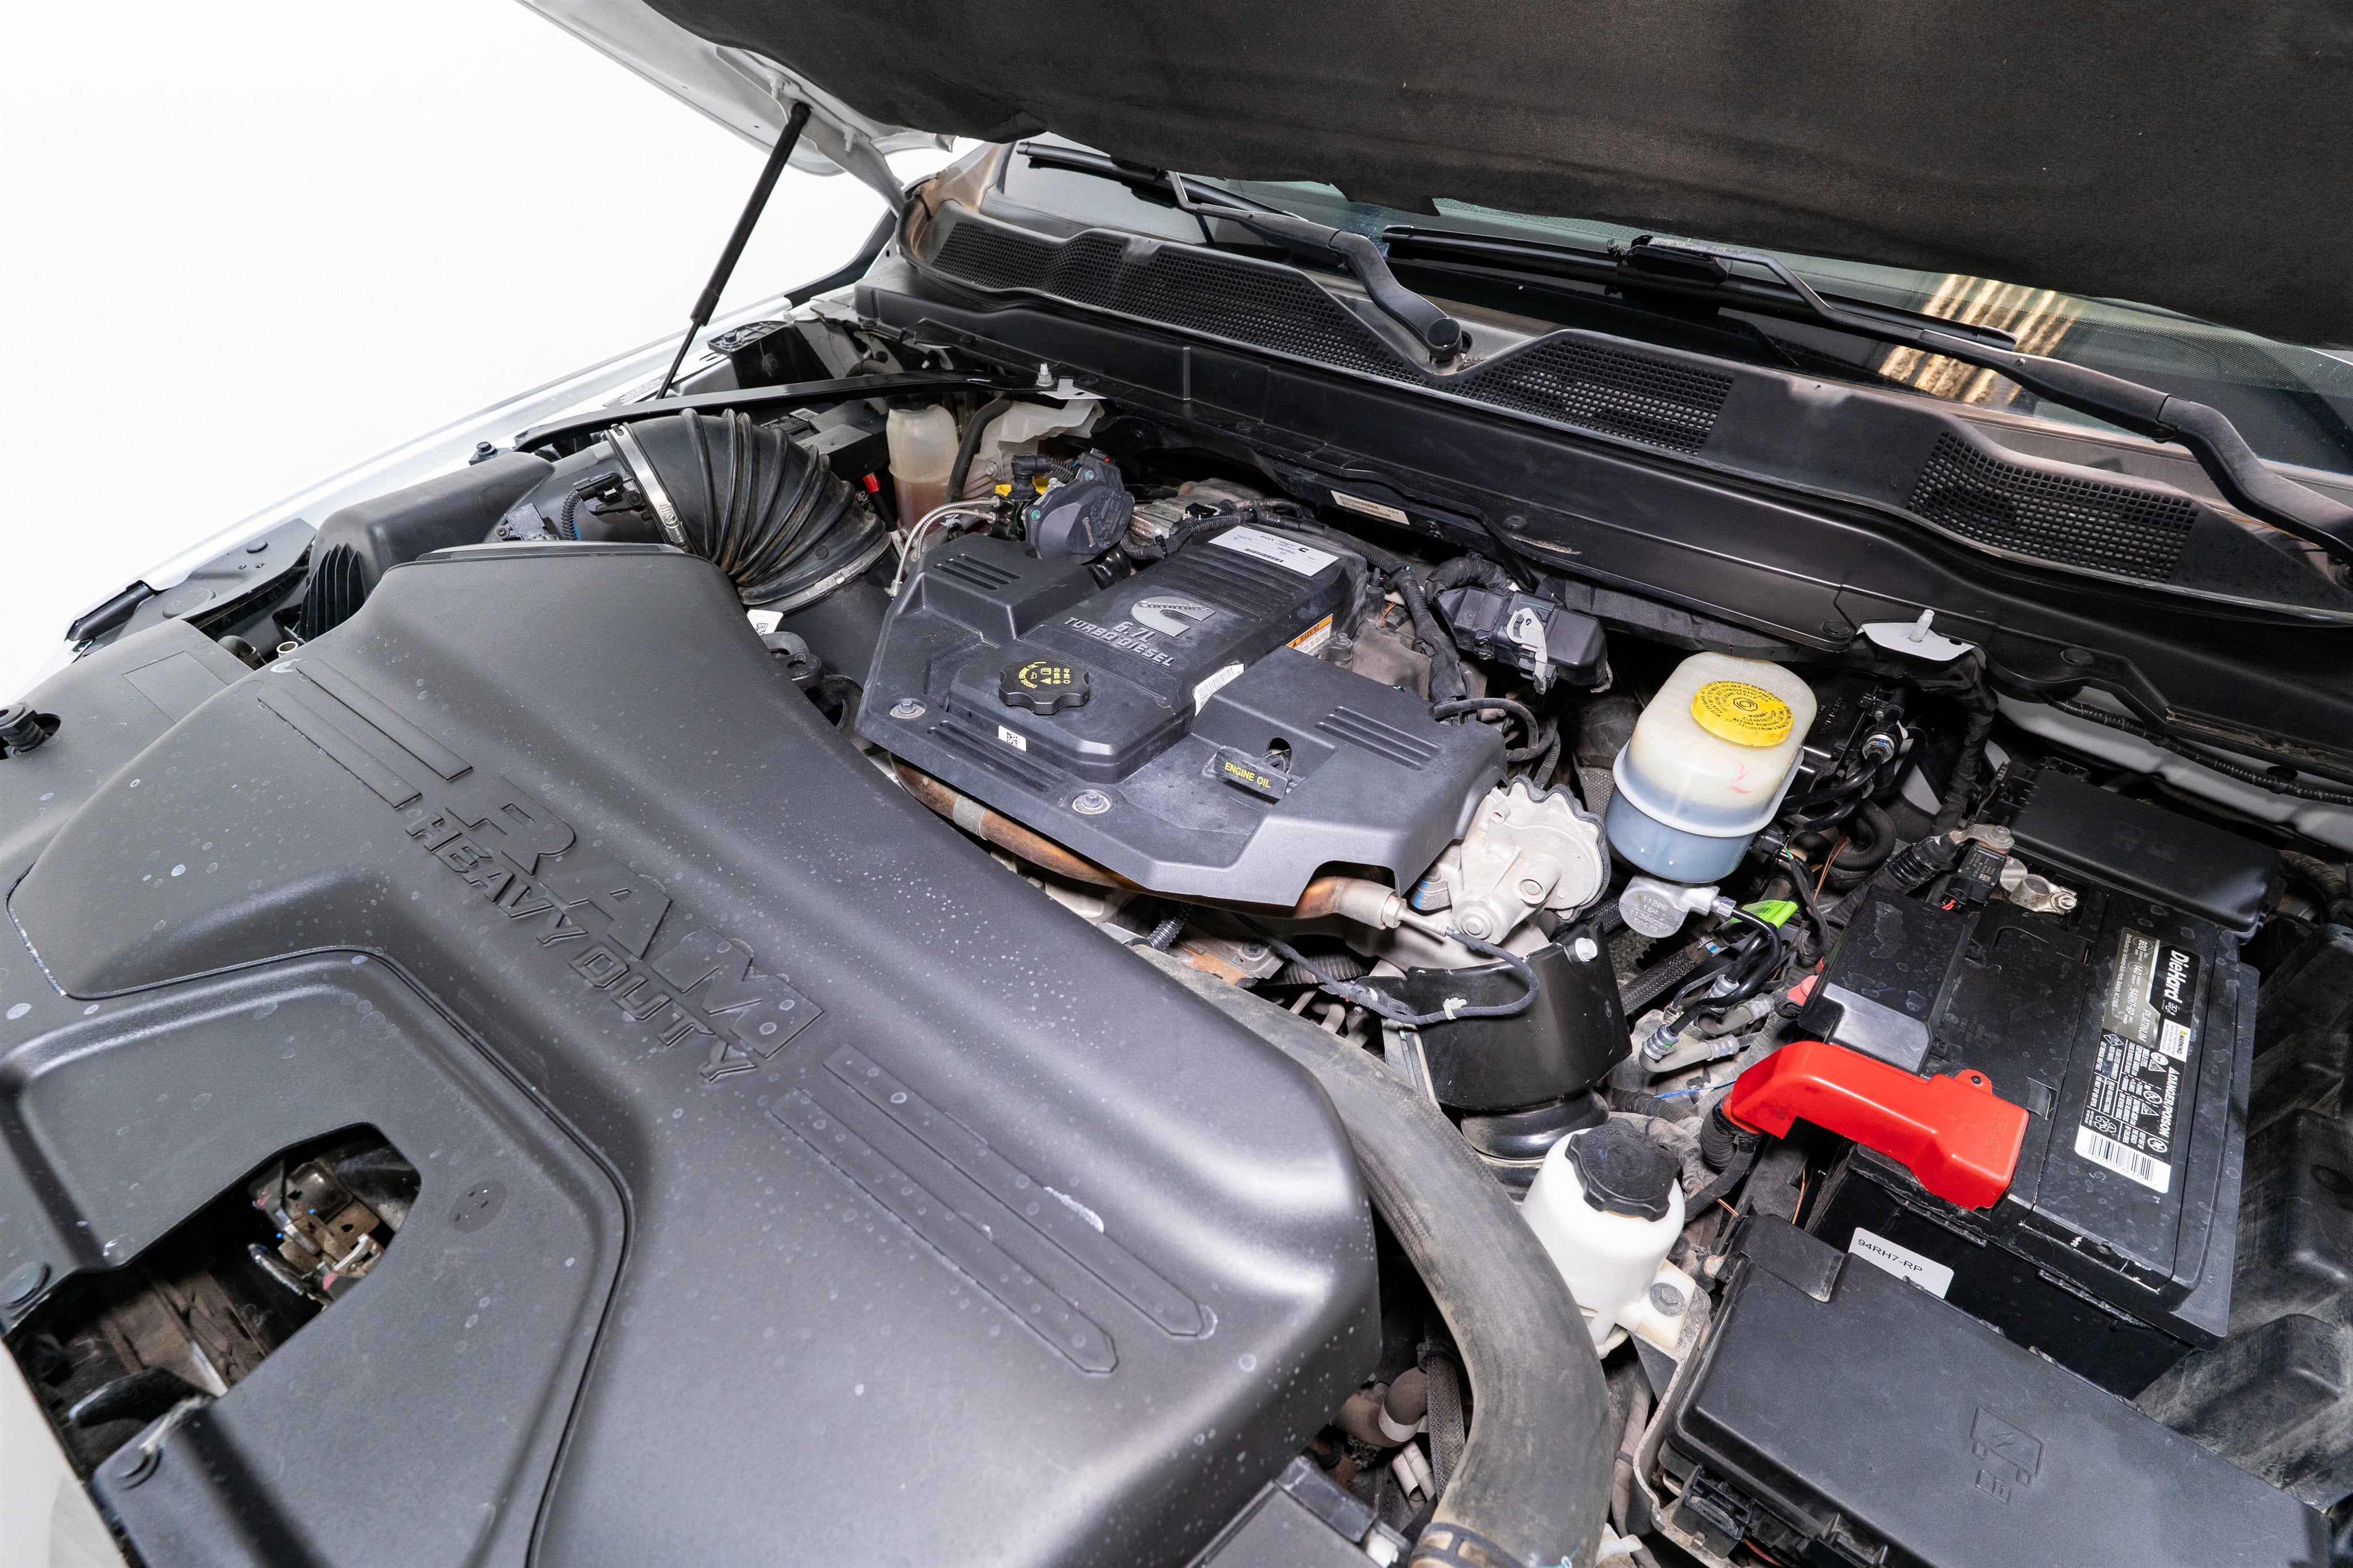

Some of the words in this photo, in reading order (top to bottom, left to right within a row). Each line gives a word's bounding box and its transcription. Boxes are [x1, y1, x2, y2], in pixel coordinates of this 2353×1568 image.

[1082, 517, 1096, 548] Continental
[1137, 601, 1211, 612] Cummins
[1113, 621, 1156, 644] 6.7L
[1300, 624, 1320, 642] WARNING
[1064, 617, 1120, 642] TURBO
[1116, 636, 1175, 668] DIESEL
[1732, 717, 1754, 725] BEFORE
[1224, 762, 1255, 782] ENGINE
[1256, 776, 1271, 789] OIL
[446, 775, 824, 1059] RAM
[1644, 905, 1658, 915] 164
[1633, 917, 1659, 933] 50673
[404, 813, 588, 947] HEAVY
[569, 944, 758, 1083] DUTY
[2123, 933, 2132, 949] Distributed
[2137, 939, 2148, 952] 800
[2120, 952, 2128, 966] Advance
[2132, 964, 2143, 976] 140
[2163, 949, 2190, 1005] DieHard
[2124, 986, 2139, 1016] 94RH7-RP
[2136, 1007, 2151, 1042] PLATINUM
[2097, 1046, 2105, 1059] MEDICAL
[2175, 1034, 2185, 1056] WARNING:
[2133, 1044, 2143, 1063] EXPLOSIVE
[2141, 1047, 2150, 1060] SHIELD
[2131, 1060, 2140, 1072] GASES
[2107, 1080, 2115, 1091] READ
[2117, 1096, 2125, 1109] SEVERE
[2125, 1095, 2133, 1107] CAUSE
[2131, 1098, 2141, 1114] SULFURIC
[2158, 1072, 2178, 1138] DANGER/POISON
[2121, 1104, 2131, 1123] BLINDNESS
[2130, 1111, 2138, 1121] ACID
[2130, 1132, 2138, 1145] REACH
[1858, 1239, 1923, 1272] 94RH7-RP
